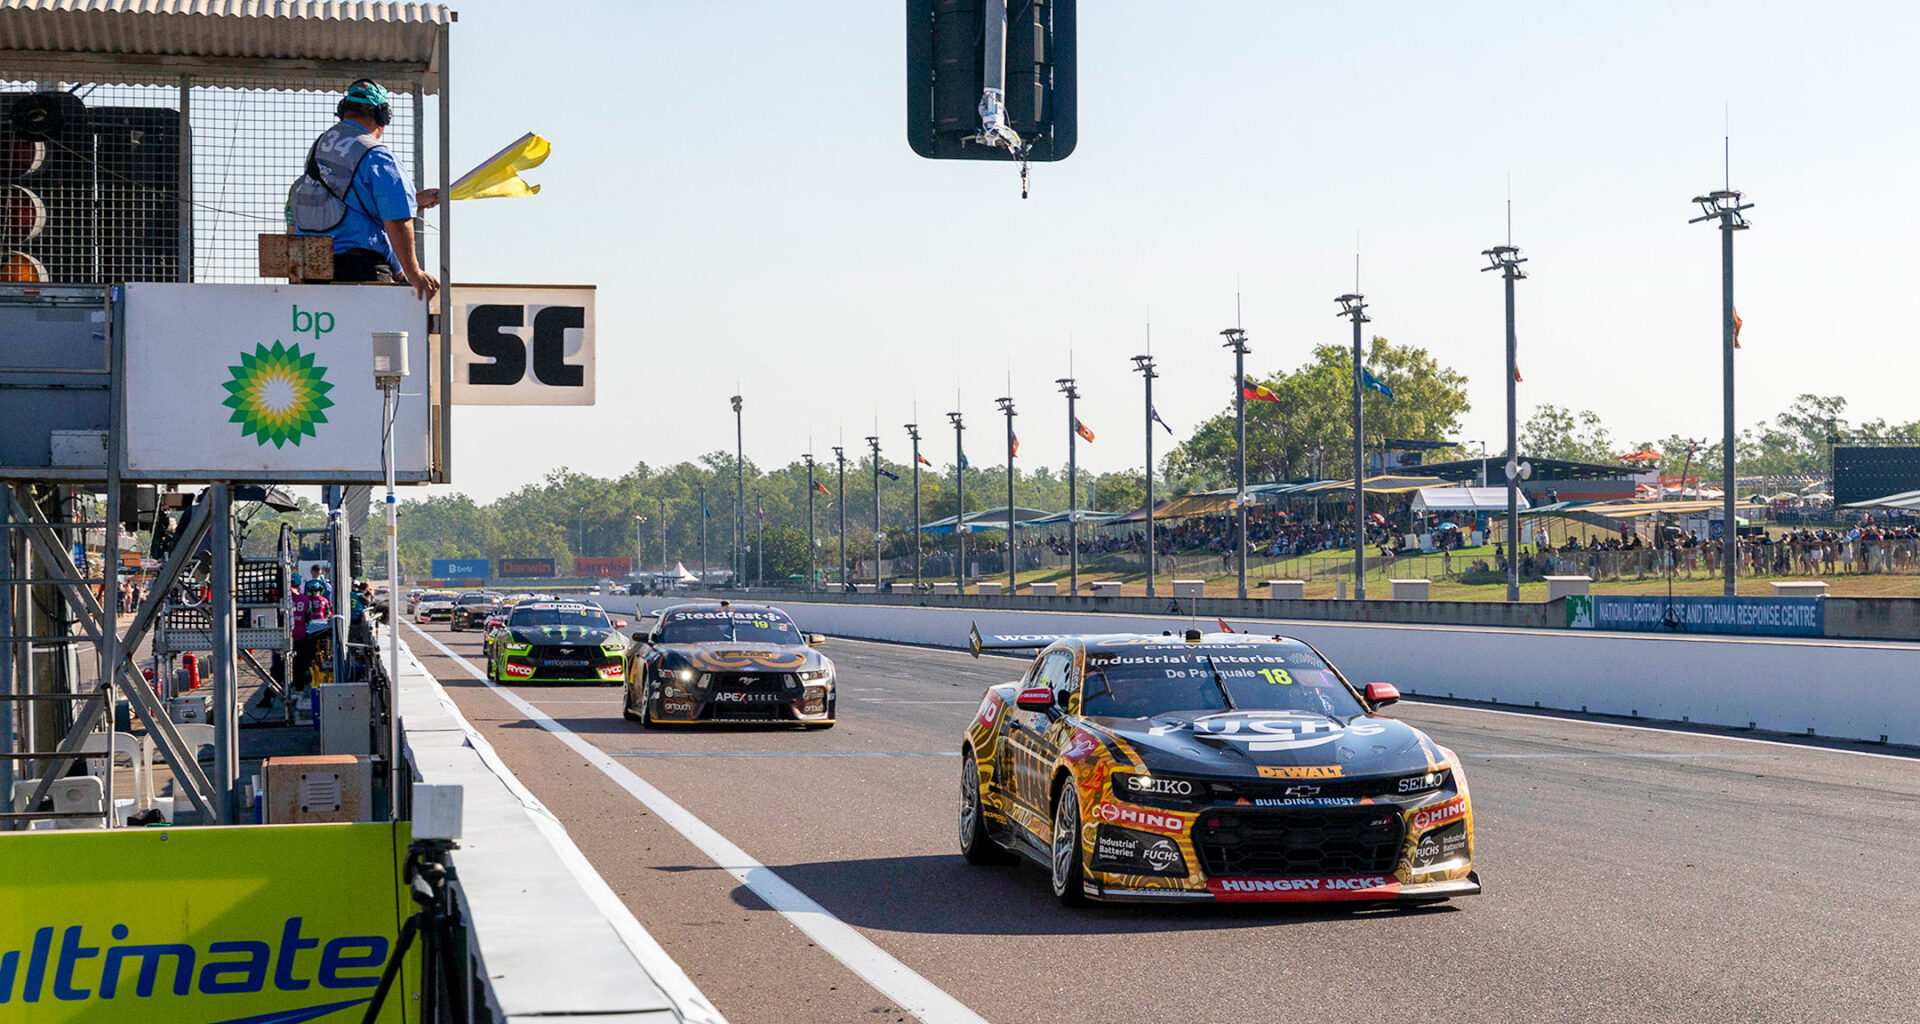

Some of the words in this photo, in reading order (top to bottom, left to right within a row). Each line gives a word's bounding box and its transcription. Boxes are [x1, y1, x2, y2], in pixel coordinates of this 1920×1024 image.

[321, 129, 356, 157] 34
[292, 304, 335, 340] bp
[467, 304, 585, 387] SC
[503, 561, 551, 573] Darwin
[675, 611, 762, 621] Steadfast
[1600, 603, 1632, 621] NATIONAL
[1633, 603, 1664, 622] CRITICAL
[1686, 604, 1701, 623] AND
[1703, 604, 1735, 624] TRAUMA
[1737, 605, 1780, 625] RESPONSE
[1781, 605, 1816, 627] CENTRE
[752, 620, 769, 629] 19
[1090, 655, 1188, 666] Industrial
[1195, 654, 1285, 664] Batteries
[507, 664, 532, 675] RYCO
[601, 665, 622, 676] RYCO
[1165, 668, 1185, 679] De
[1190, 667, 1255, 680] Paquale
[1257, 668, 1293, 685] 18
[715, 692, 747, 703] APEX
[1128, 776, 1192, 795] SEIKO
[1255, 797, 1314, 807] BUILDING
[1319, 796, 1355, 806] TRUST
[1431, 801, 1466, 822] HINO
[1121, 810, 1182, 830] HINO
[1100, 837, 1136, 849] Industrial
[1443, 841, 1465, 853] Batteries
[1099, 845, 1134, 857] Batteries
[1143, 849, 1179, 862] FUCHS
[1415, 845, 1440, 858] FUCHS
[1222, 878, 1319, 892] HUNGRY
